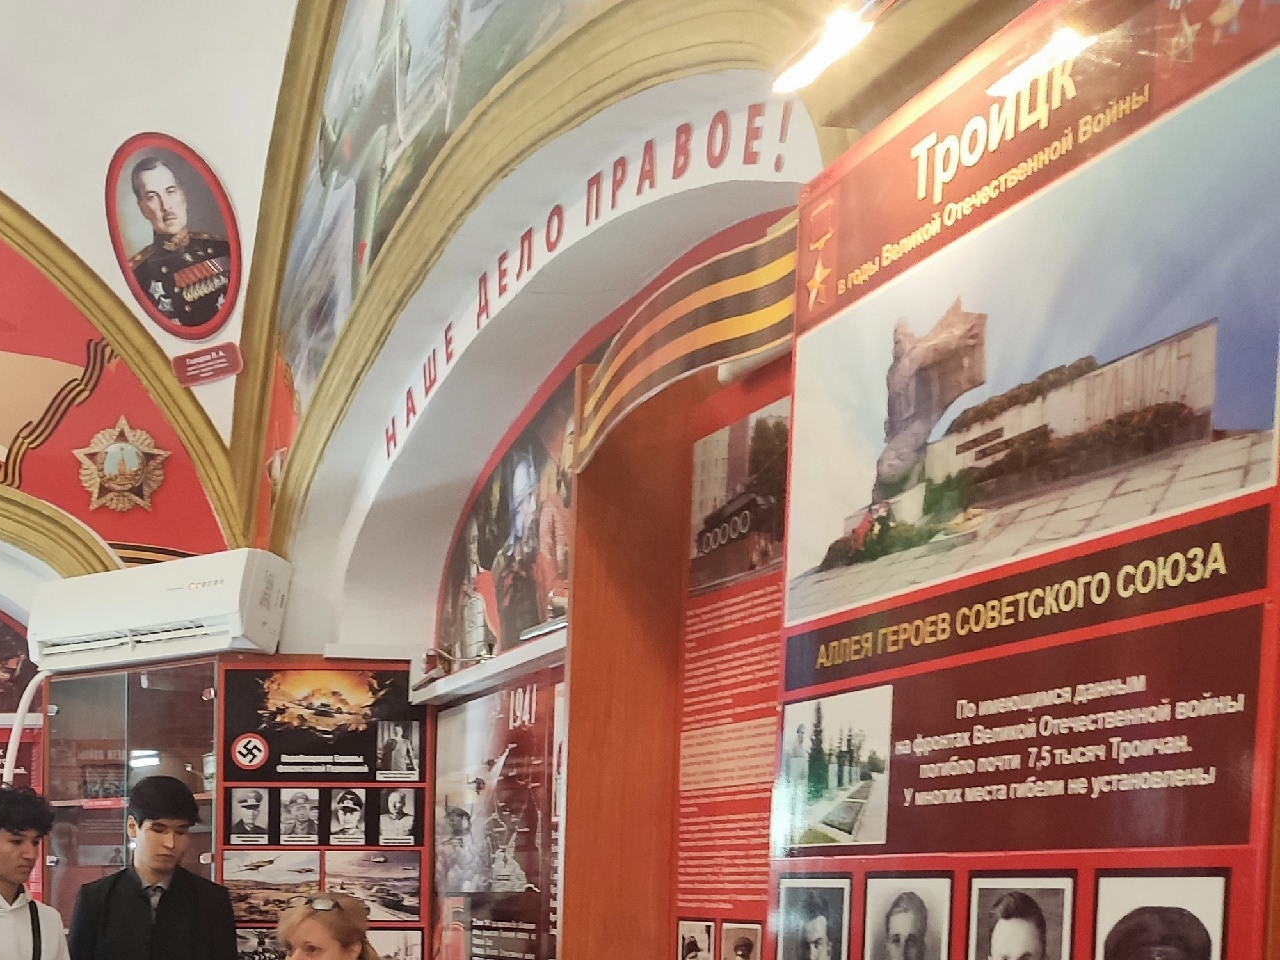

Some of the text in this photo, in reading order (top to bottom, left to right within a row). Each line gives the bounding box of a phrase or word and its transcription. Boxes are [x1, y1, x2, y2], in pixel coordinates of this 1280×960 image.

[837, 83, 1150, 294] в годы Великой Отечественной Войны
[385, 100, 794, 460] НАШЕ ДЕЛО ПРАВОЕ!
[816, 542, 1227, 669] АЛЛЕЯ ГЕРОЕВ СОВЕТСКОГО СОЮЗА
[895, 692, 1245, 757] на фронтах Великой Отечественной войны
[956, 675, 1147, 719] По имеющимся данным
[903, 788, 913, 807] У
[964, 783, 1007, 802] места
[1009, 776, 1065, 800] гибели
[1068, 777, 1088, 794] не
[1091, 767, 1216, 799] установлены
[919, 756, 975, 779] погибло
[977, 754, 1021, 773] почти
[1028, 746, 1051, 770] 7,5
[1054, 745, 1106, 766] тысяч
